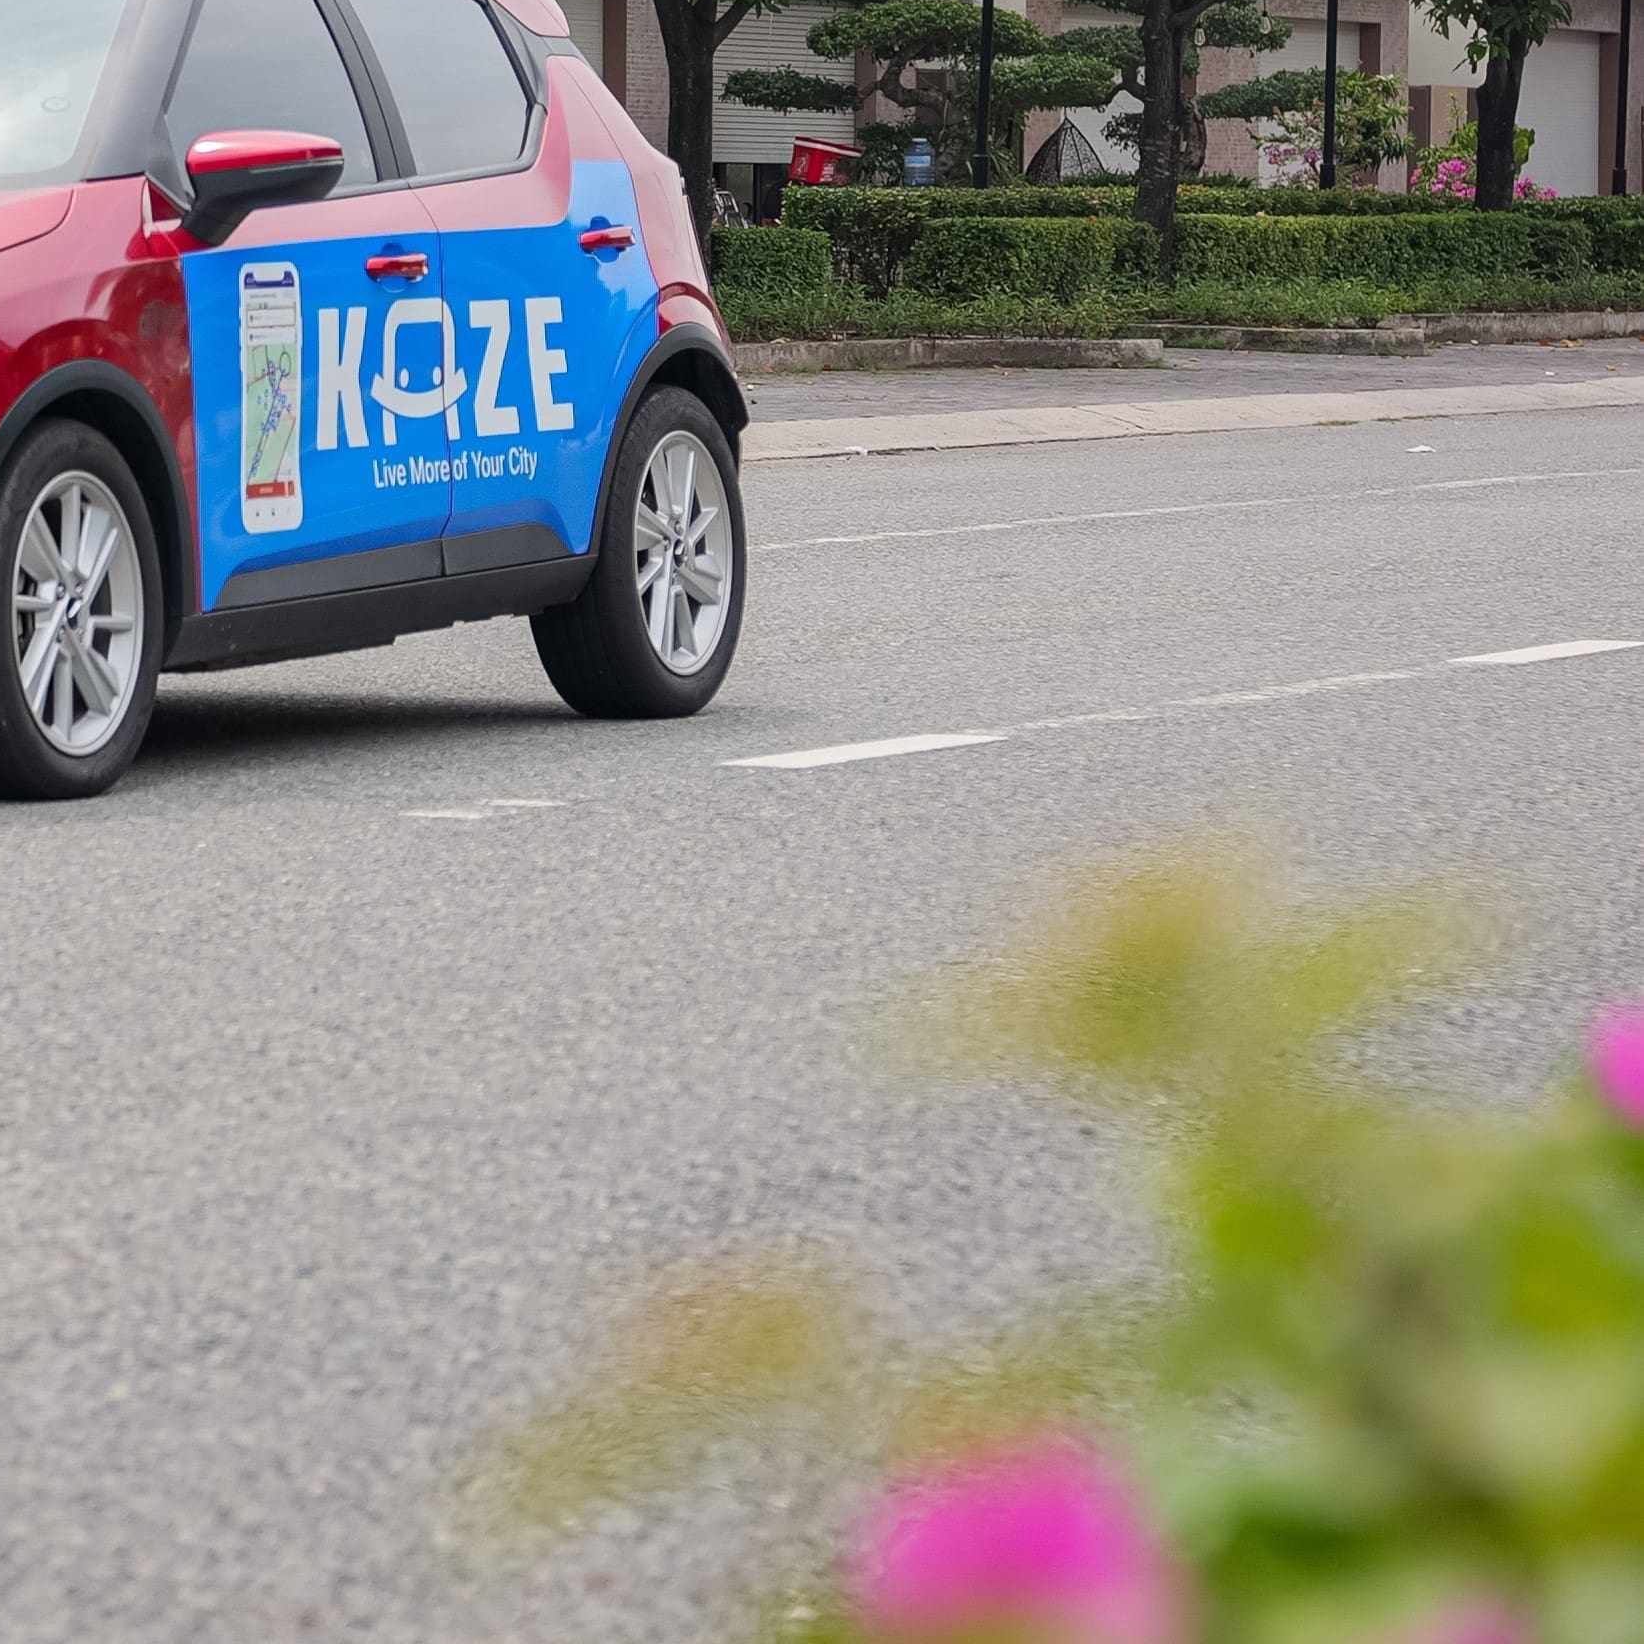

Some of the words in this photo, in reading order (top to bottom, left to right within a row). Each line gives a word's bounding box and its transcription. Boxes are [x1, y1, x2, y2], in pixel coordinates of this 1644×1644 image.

[373, 458, 407, 488] Live
[409, 455, 450, 485] More
[452, 451, 468, 481] of
[470, 451, 505, 479] Your
[508, 446, 538, 481] City
